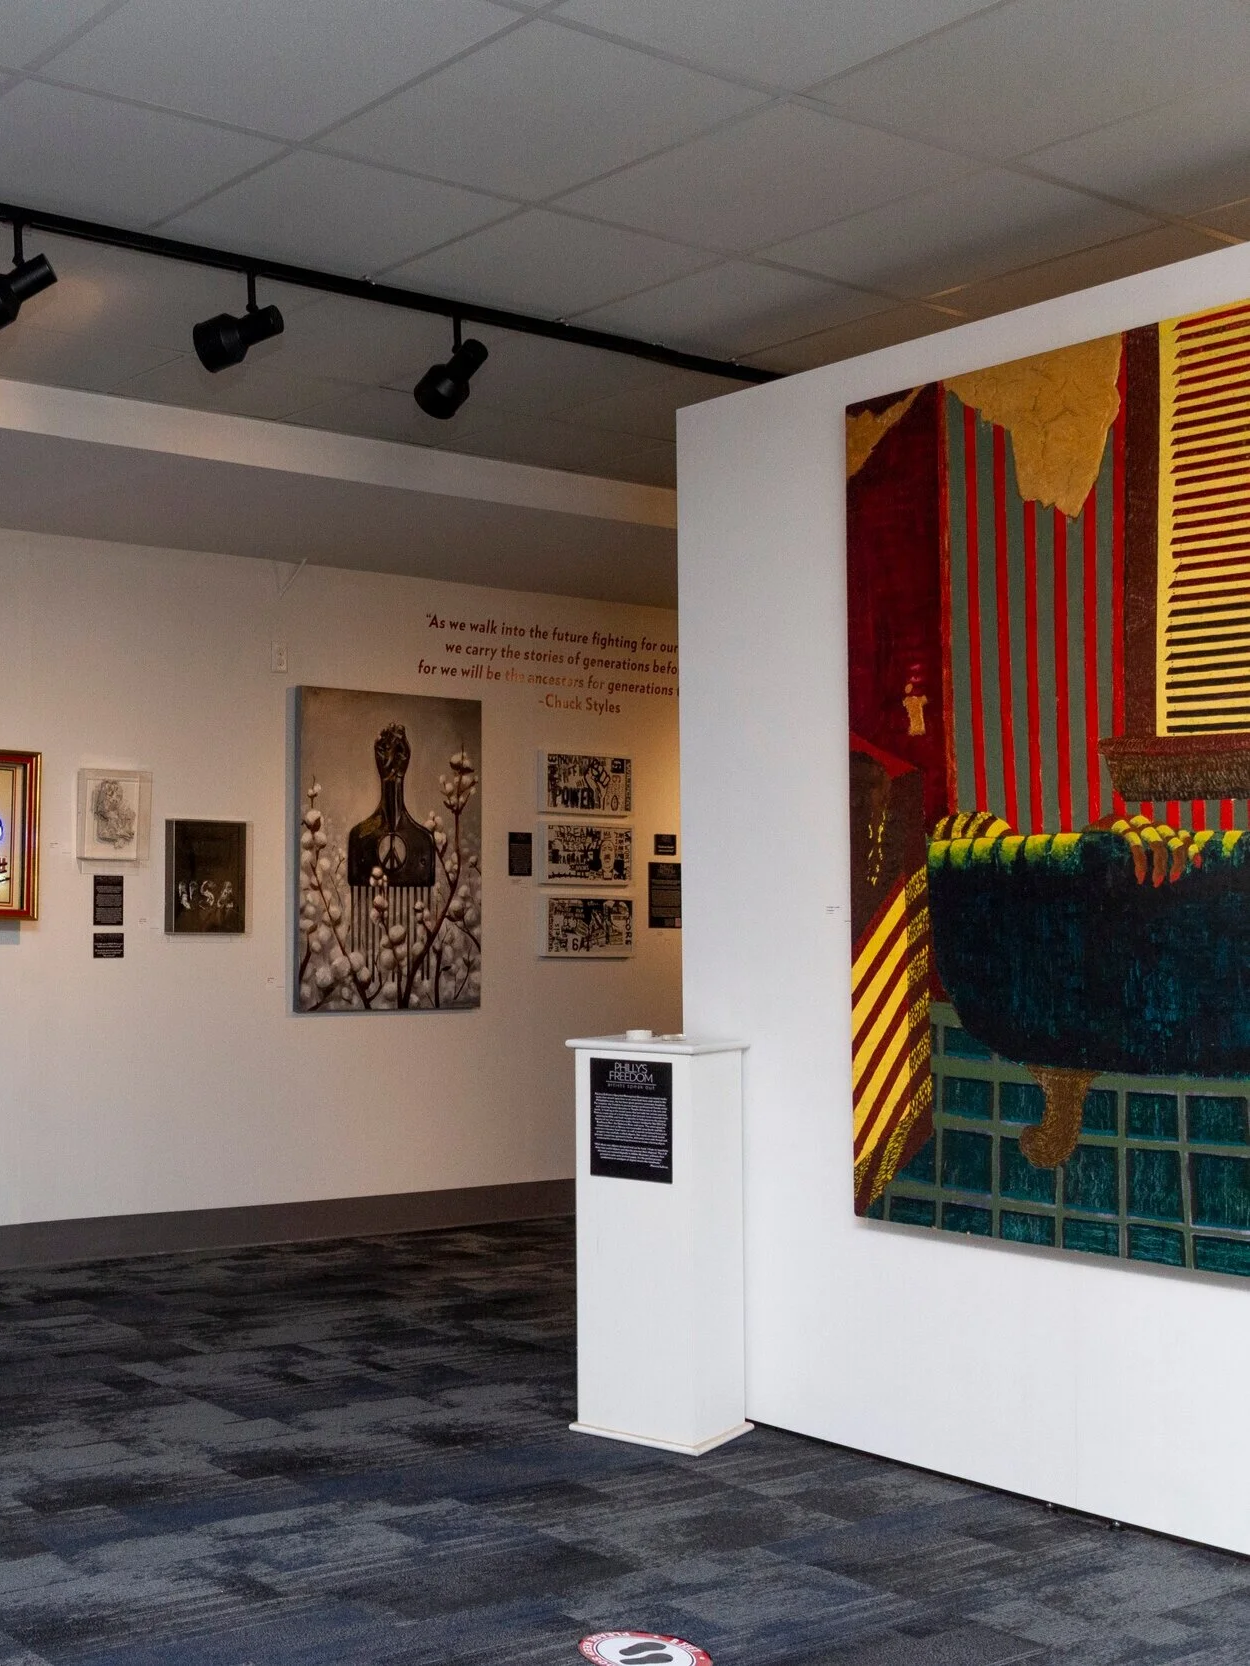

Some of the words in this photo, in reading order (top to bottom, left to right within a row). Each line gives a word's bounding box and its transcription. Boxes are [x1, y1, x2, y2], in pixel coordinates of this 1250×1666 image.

[448, 620, 466, 632] we
[470, 620, 498, 635] walk
[501, 622, 527, 638] into
[529, 625, 549, 640] the
[552, 627, 589, 645] future
[592, 631, 638, 654] fighting
[640, 636, 658, 653] for
[445, 642, 462, 654] we
[465, 645, 498, 661] carry
[501, 644, 521, 660] the
[524, 650, 565, 665] stories
[567, 651, 581, 666] of
[582, 656, 650, 673] generations
[653, 660, 678, 675] befo
[418, 660, 438, 675] for
[440, 666, 458, 677] we
[460, 664, 483, 680] will
[486, 666, 501, 681] be
[504, 668, 525, 683] the
[526, 671, 585, 689] ancestors
[587, 675, 606, 690] for
[608, 678, 674, 697] generations
[585, 697, 621, 716] Styles
[608, 1070, 654, 1084] FREEDOM
